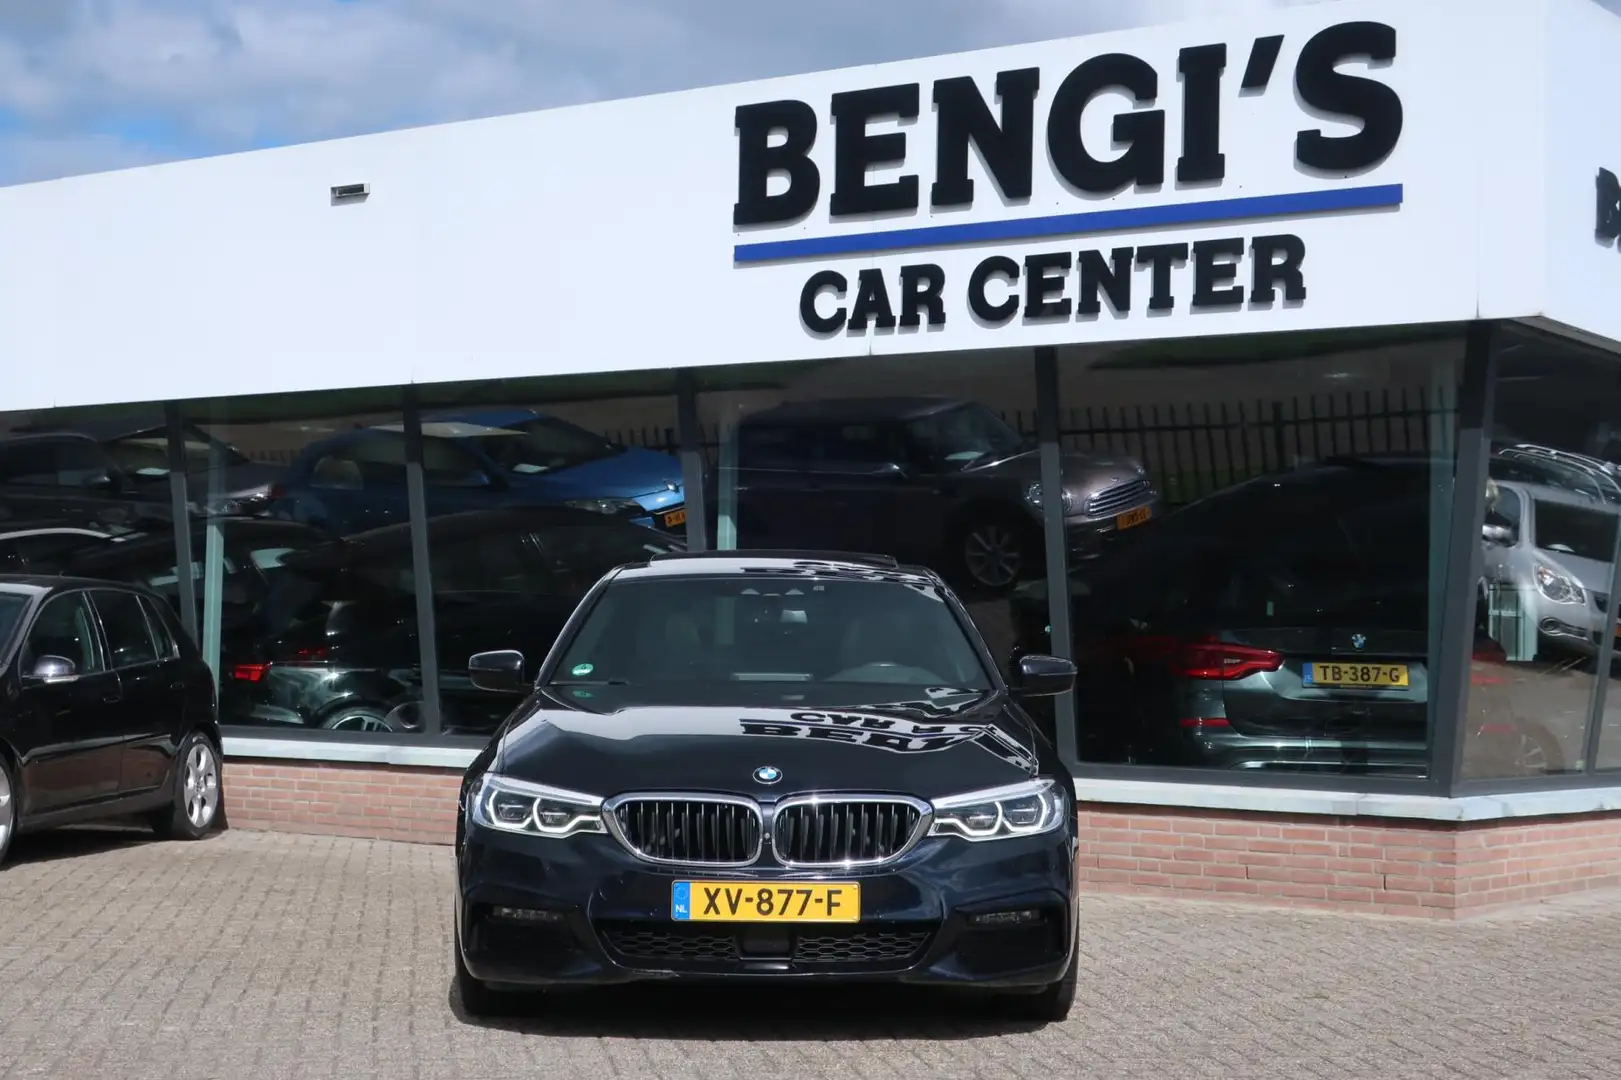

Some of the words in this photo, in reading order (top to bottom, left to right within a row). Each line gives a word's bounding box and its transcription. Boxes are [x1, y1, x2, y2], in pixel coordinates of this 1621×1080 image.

[734, 22, 1403, 229] BENGI'S
[800, 264, 946, 333] CAR
[968, 234, 1307, 325] CENTER
[1319, 665, 1401, 683] TB-387-G
[675, 904, 688, 913] NL
[703, 887, 842, 916] XV-877-F
